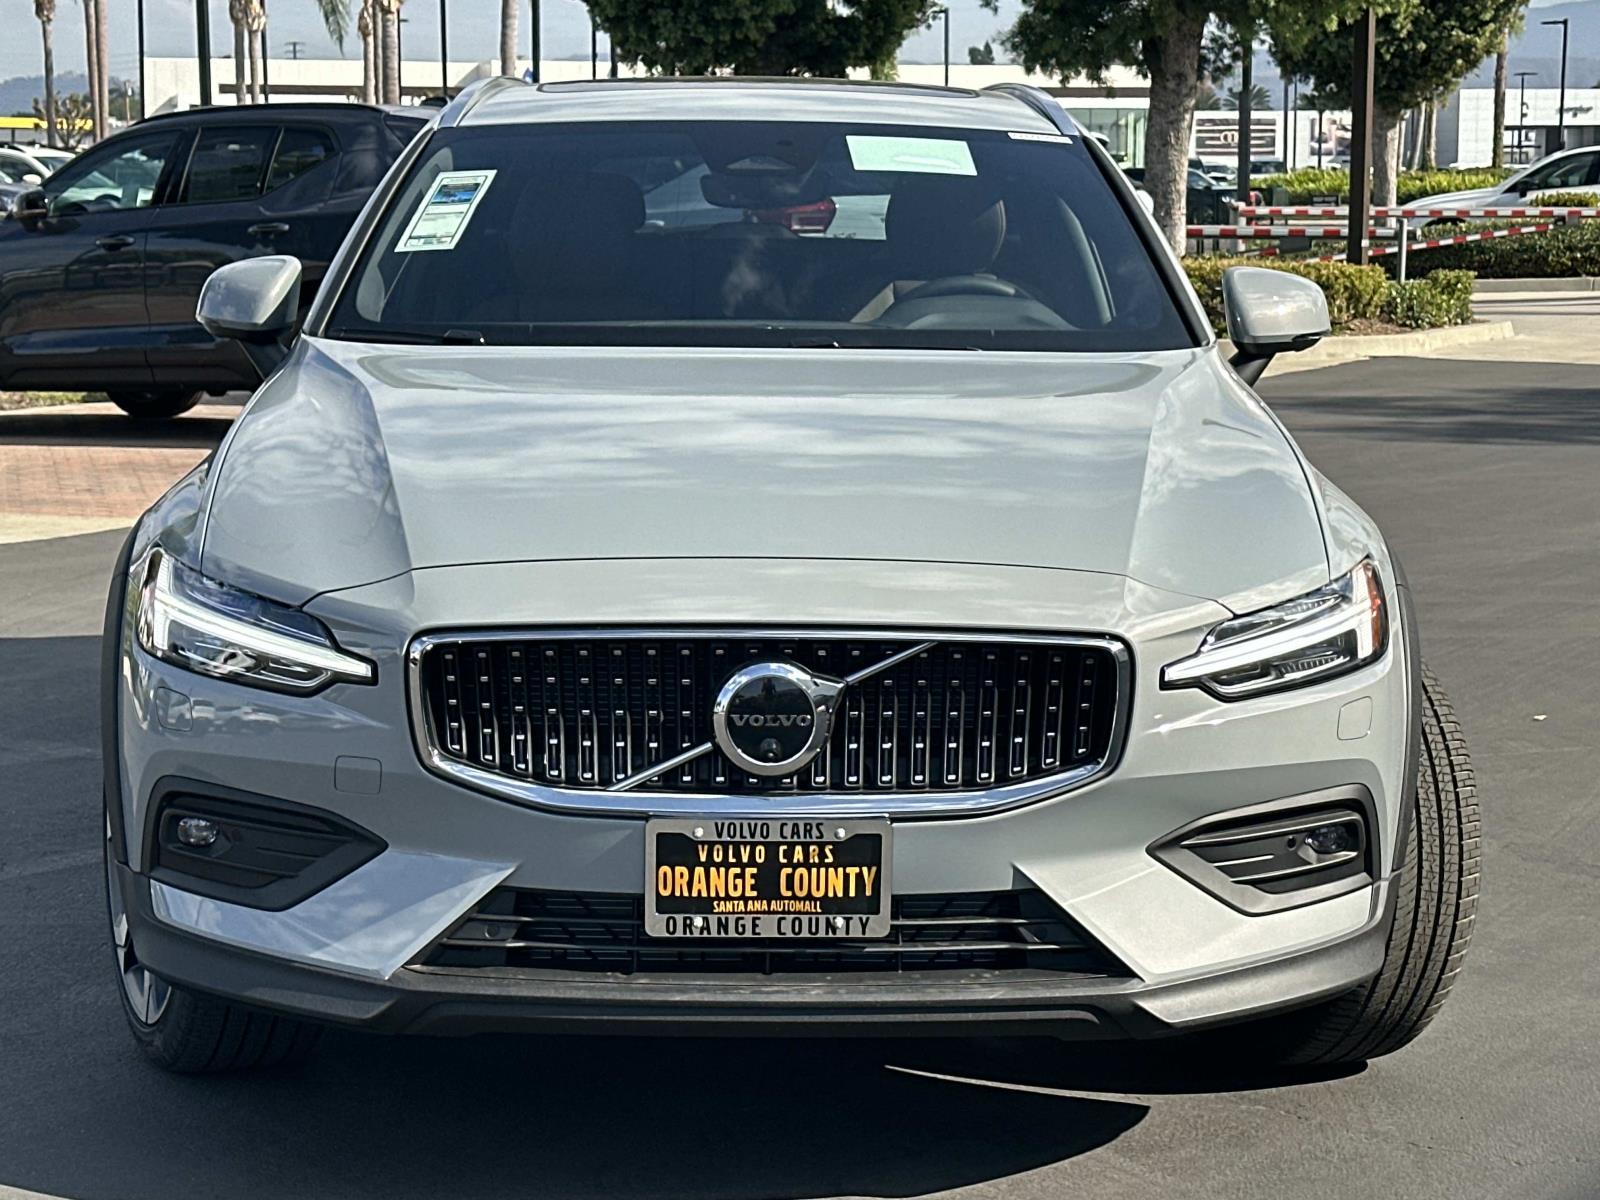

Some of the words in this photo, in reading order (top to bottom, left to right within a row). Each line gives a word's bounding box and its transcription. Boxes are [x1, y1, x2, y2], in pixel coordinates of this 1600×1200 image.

[730, 714, 811, 726] VOLVO
[714, 822, 770, 839] VOLVO
[780, 822, 824, 839] CARS
[698, 844, 765, 863] VOLVO
[778, 845, 834, 863] CARS
[658, 865, 758, 897] ORANGE
[780, 866, 877, 898] COUNTY
[713, 900, 745, 913] SANTA
[747, 900, 768, 912] ANA
[770, 900, 822, 913] AUTOMALL
[665, 916, 762, 936] ORANGE
[776, 916, 870, 936] COUNTY
